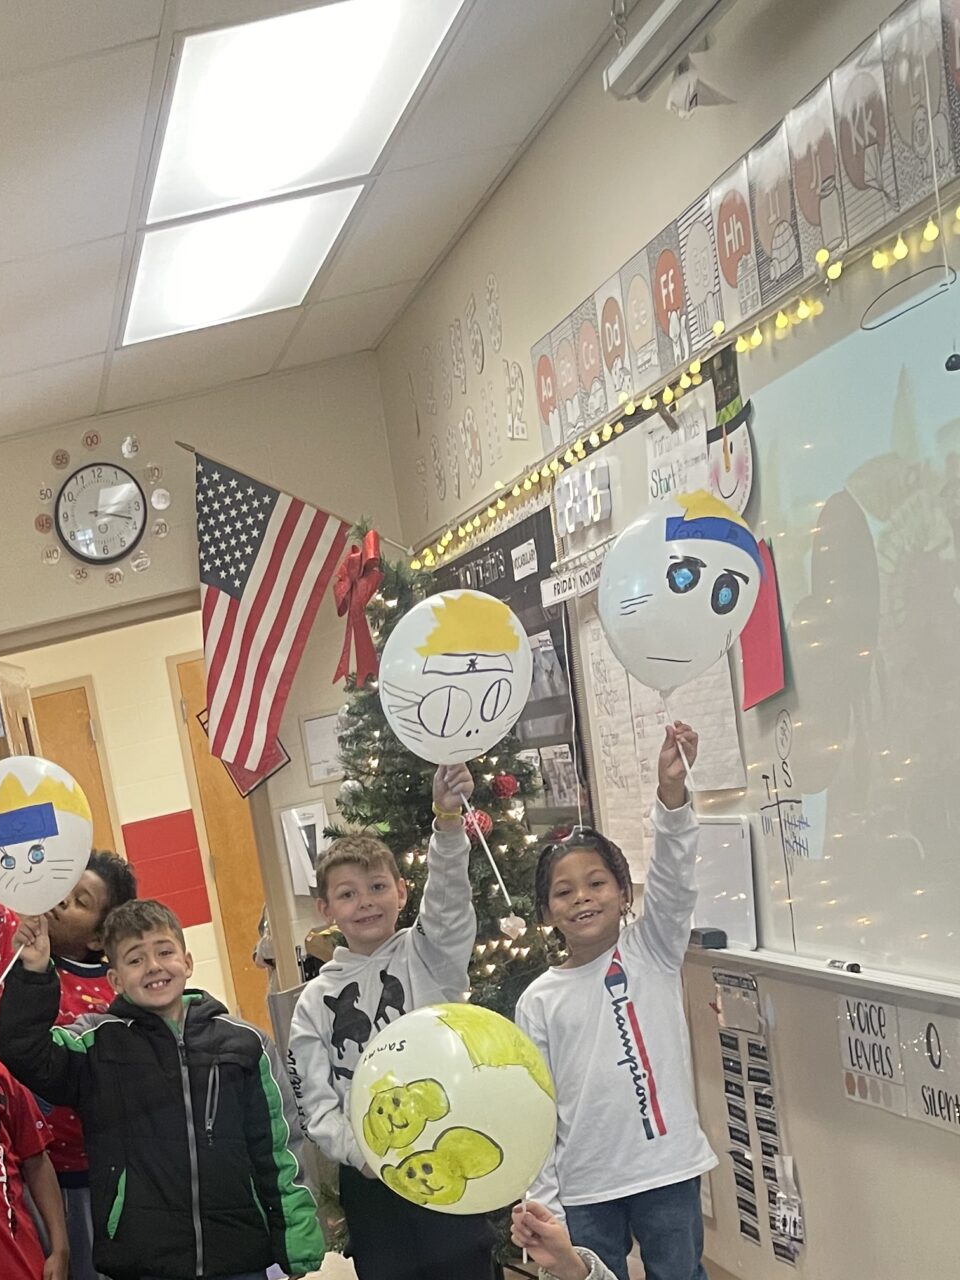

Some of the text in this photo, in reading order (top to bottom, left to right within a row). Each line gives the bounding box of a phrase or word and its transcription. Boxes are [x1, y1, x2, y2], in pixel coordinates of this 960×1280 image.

[849, 102, 877, 155] Kk
[723, 213, 745, 258] Hh
[659, 269, 676, 310] Ff
[604, 315, 621, 353] Dd
[541, 375, 553, 403] Aa
[85, 434, 99, 447] 00
[55, 454, 68, 466] 55
[91, 467, 103, 479] 12
[113, 471, 119, 481] 1
[74, 475, 85, 486] 11
[40, 488, 53, 501] 50
[63, 491, 74, 502] 10
[134, 501, 141, 512] 3
[62, 511, 69, 522] 9
[37, 518, 52, 530] 45
[154, 522, 168, 534] 20
[69, 531, 76, 541] 8
[119, 537, 126, 548] 5
[45, 549, 59, 561] 40
[102, 545, 110, 556] 6
[75, 567, 88, 580] 35
[107, 572, 122, 584] 30
[553, 576, 577, 598] FRIDAY
[781, 760, 793, 789] S
[604, 952, 648, 1118] Champion
